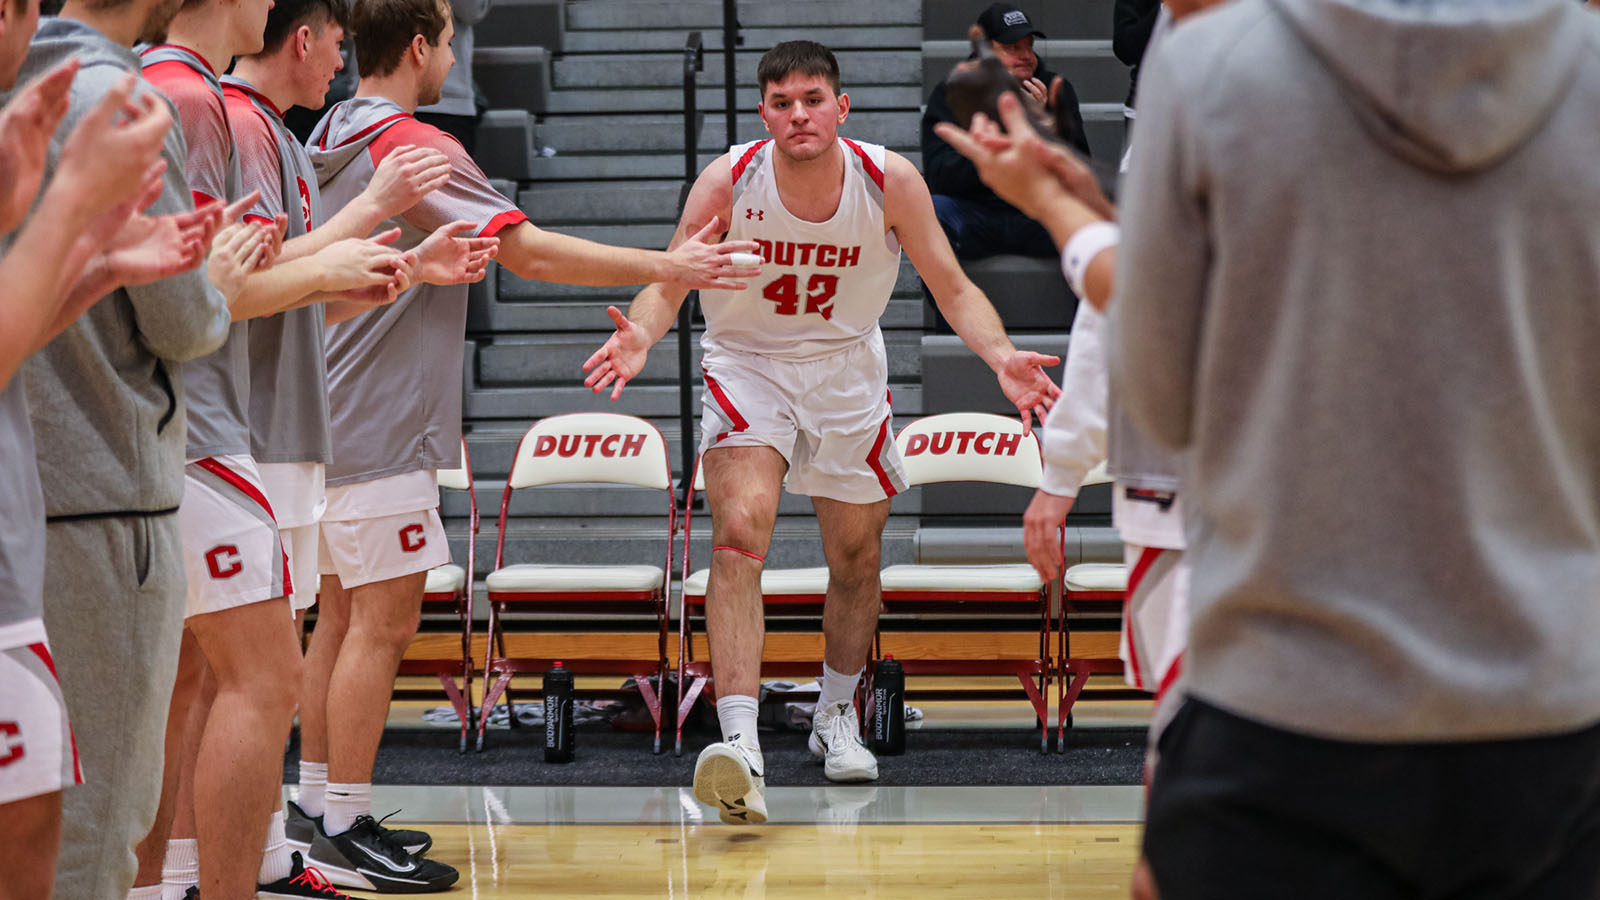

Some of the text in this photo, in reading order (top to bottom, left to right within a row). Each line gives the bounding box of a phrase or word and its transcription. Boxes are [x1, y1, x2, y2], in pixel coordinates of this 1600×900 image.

[752, 238, 861, 268] DUTCH
[763, 273, 840, 320] 42
[533, 434, 648, 458] DUTCH
[904, 431, 1022, 457] DUTCH
[398, 523, 427, 552] C
[204, 544, 243, 580] C
[546, 695, 555, 748] BODYARMOR
[875, 688, 883, 740] BODYARMOR
